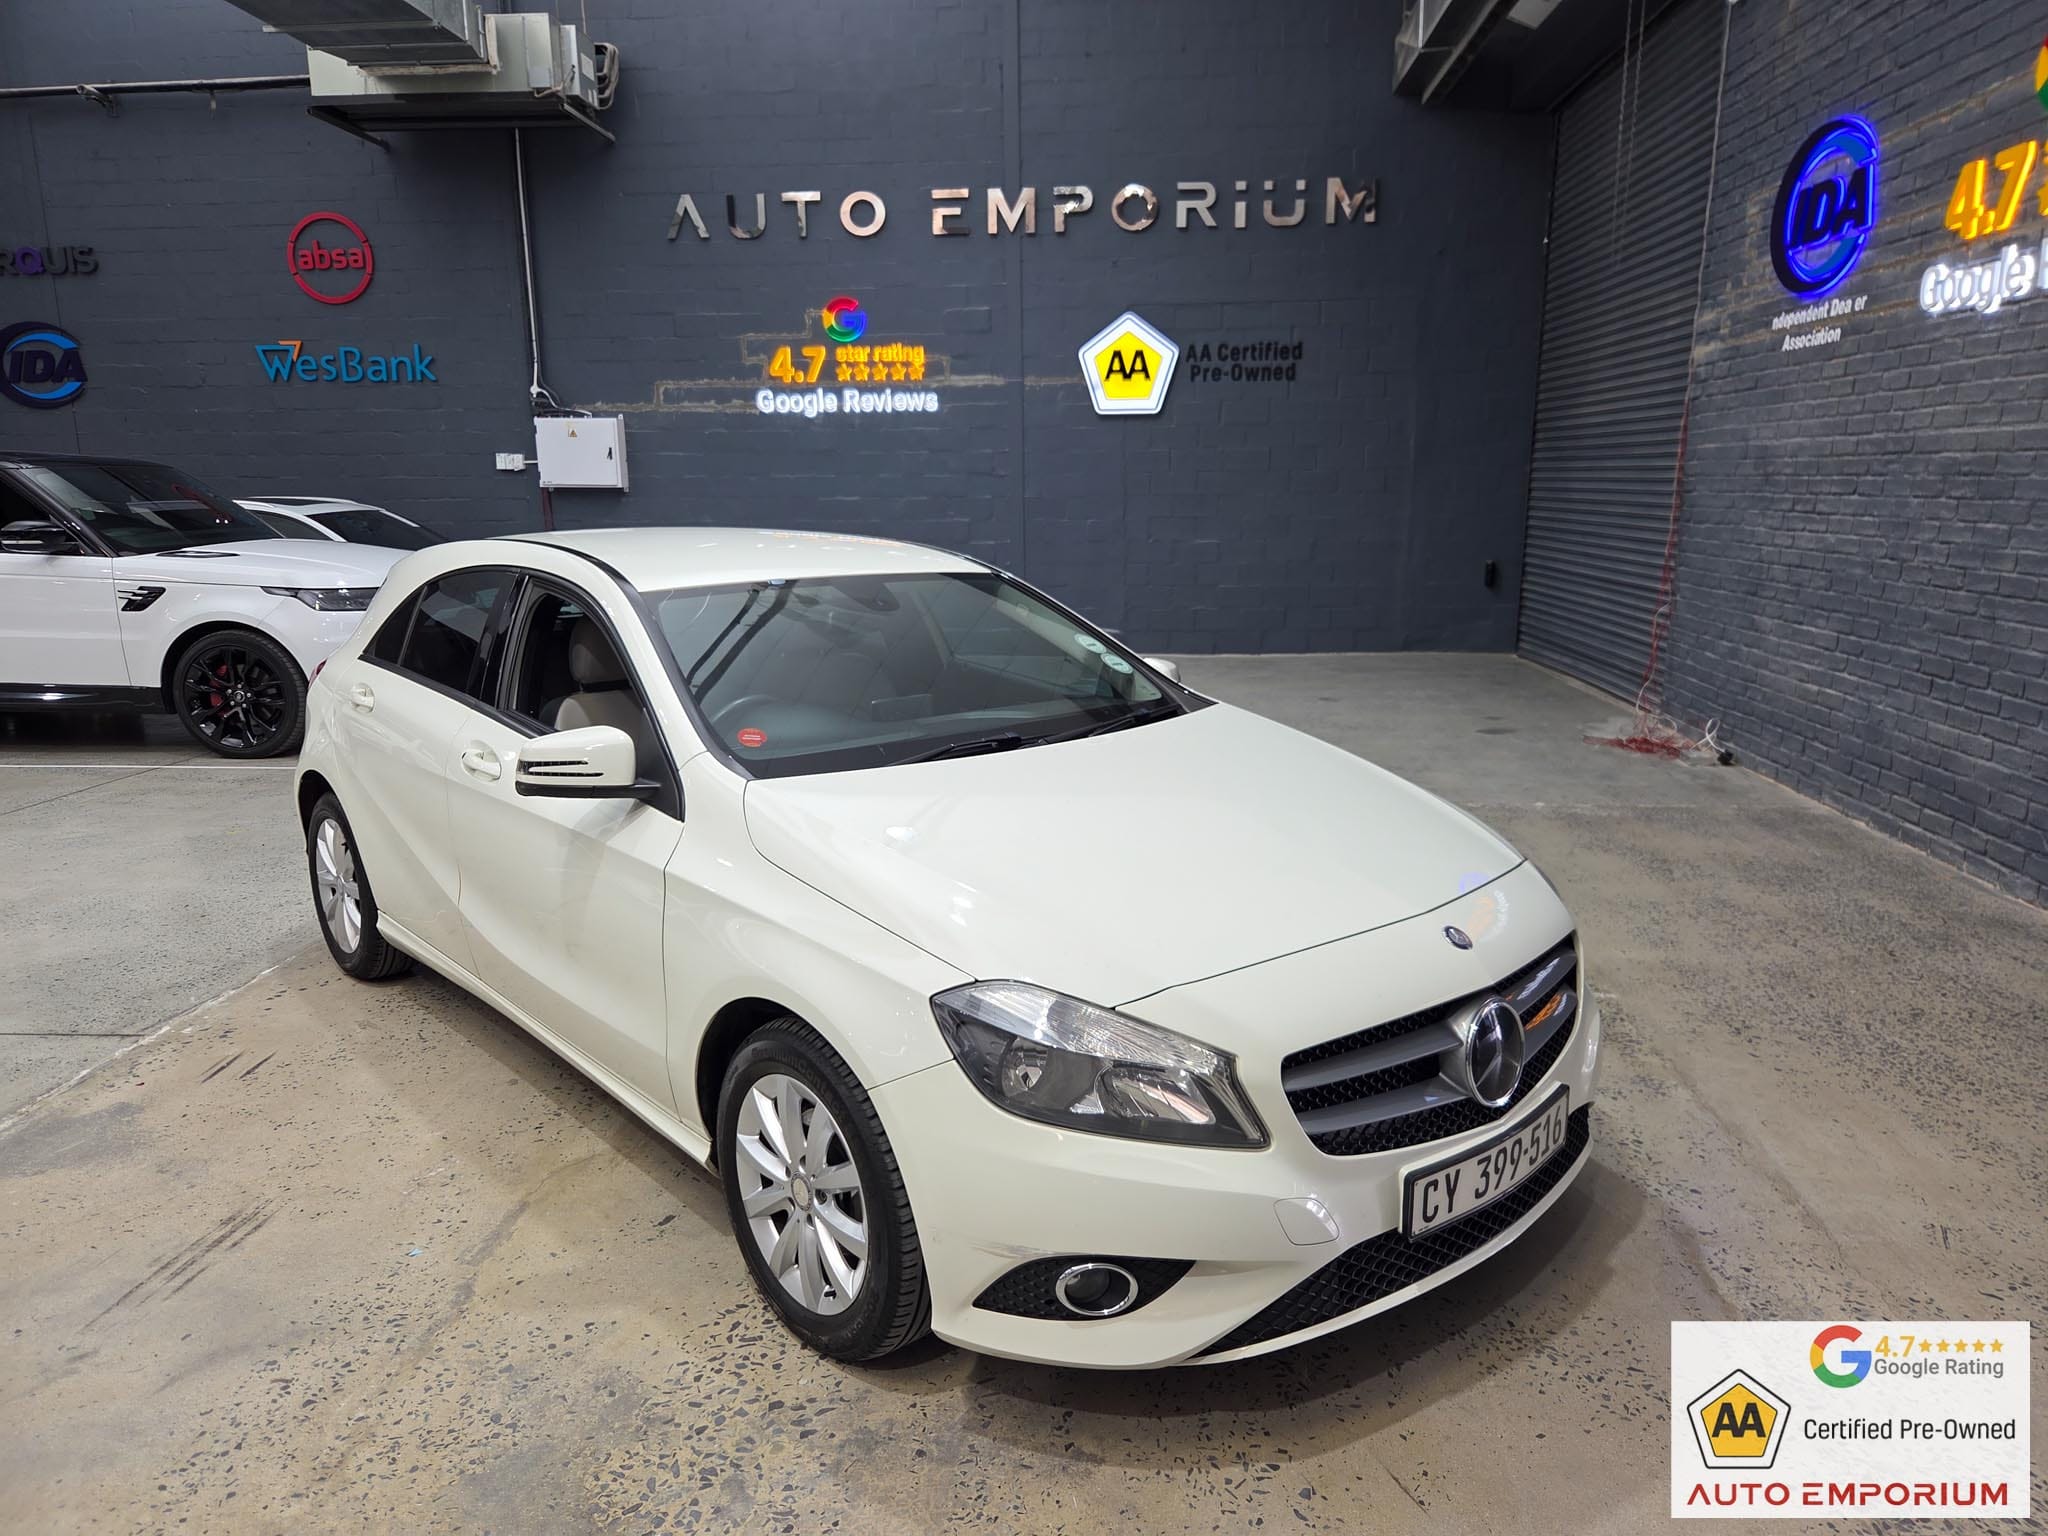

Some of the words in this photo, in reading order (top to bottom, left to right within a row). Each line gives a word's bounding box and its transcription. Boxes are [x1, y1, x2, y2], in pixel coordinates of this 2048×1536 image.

[1788, 164, 1873, 252] IDA
[1944, 140, 2038, 240] 4.7
[667, 190, 886, 240] AUTO
[298, 239, 364, 270] absa
[1920, 243, 2036, 314] Google
[1186, 344, 1212, 363] AA
[1217, 341, 1304, 362] Certified
[1781, 327, 1841, 352] Association
[8, 350, 88, 383] IDA
[255, 340, 437, 384] WesBank
[769, 344, 827, 384] 4.7
[835, 345, 871, 363] star
[873, 342, 926, 367] rating
[1104, 350, 1151, 381] AA
[1190, 362, 1298, 383] Pre-Owned
[756, 388, 838, 418] Google
[842, 388, 939, 414] Reviews
[1422, 1168, 1461, 1223] CY
[1474, 1105, 1562, 1200] 399-516
